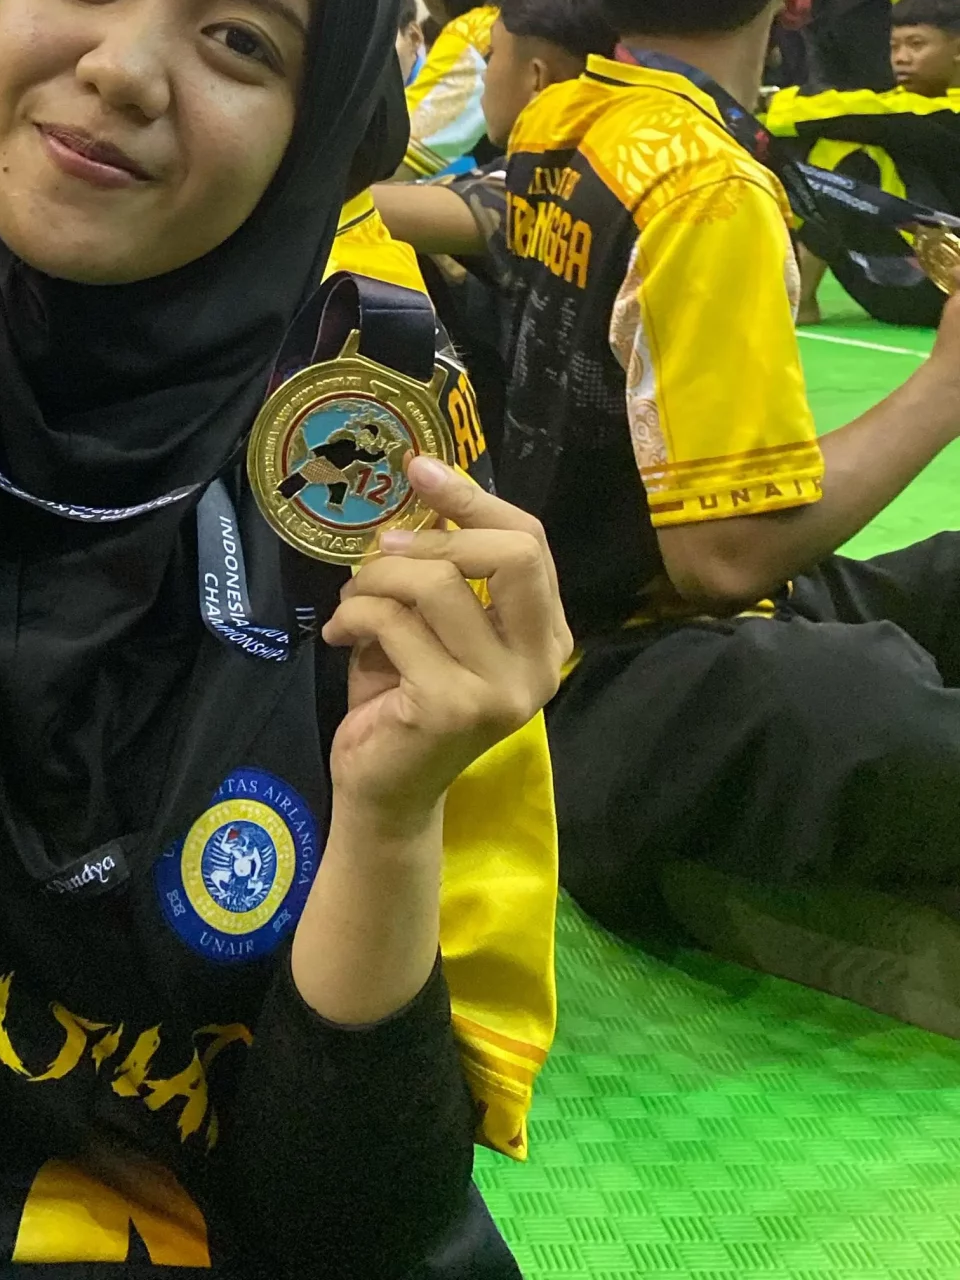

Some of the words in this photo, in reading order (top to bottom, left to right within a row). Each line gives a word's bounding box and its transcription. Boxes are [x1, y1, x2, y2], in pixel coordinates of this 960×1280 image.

[354, 467, 393, 508] 12
[204, 571, 284, 659] CHAMPIONSHIP
[218, 515, 250, 628] INDONESIA
[262, 784, 314, 886] AIRLANGGA
[199, 930, 255, 956] UNAIR
